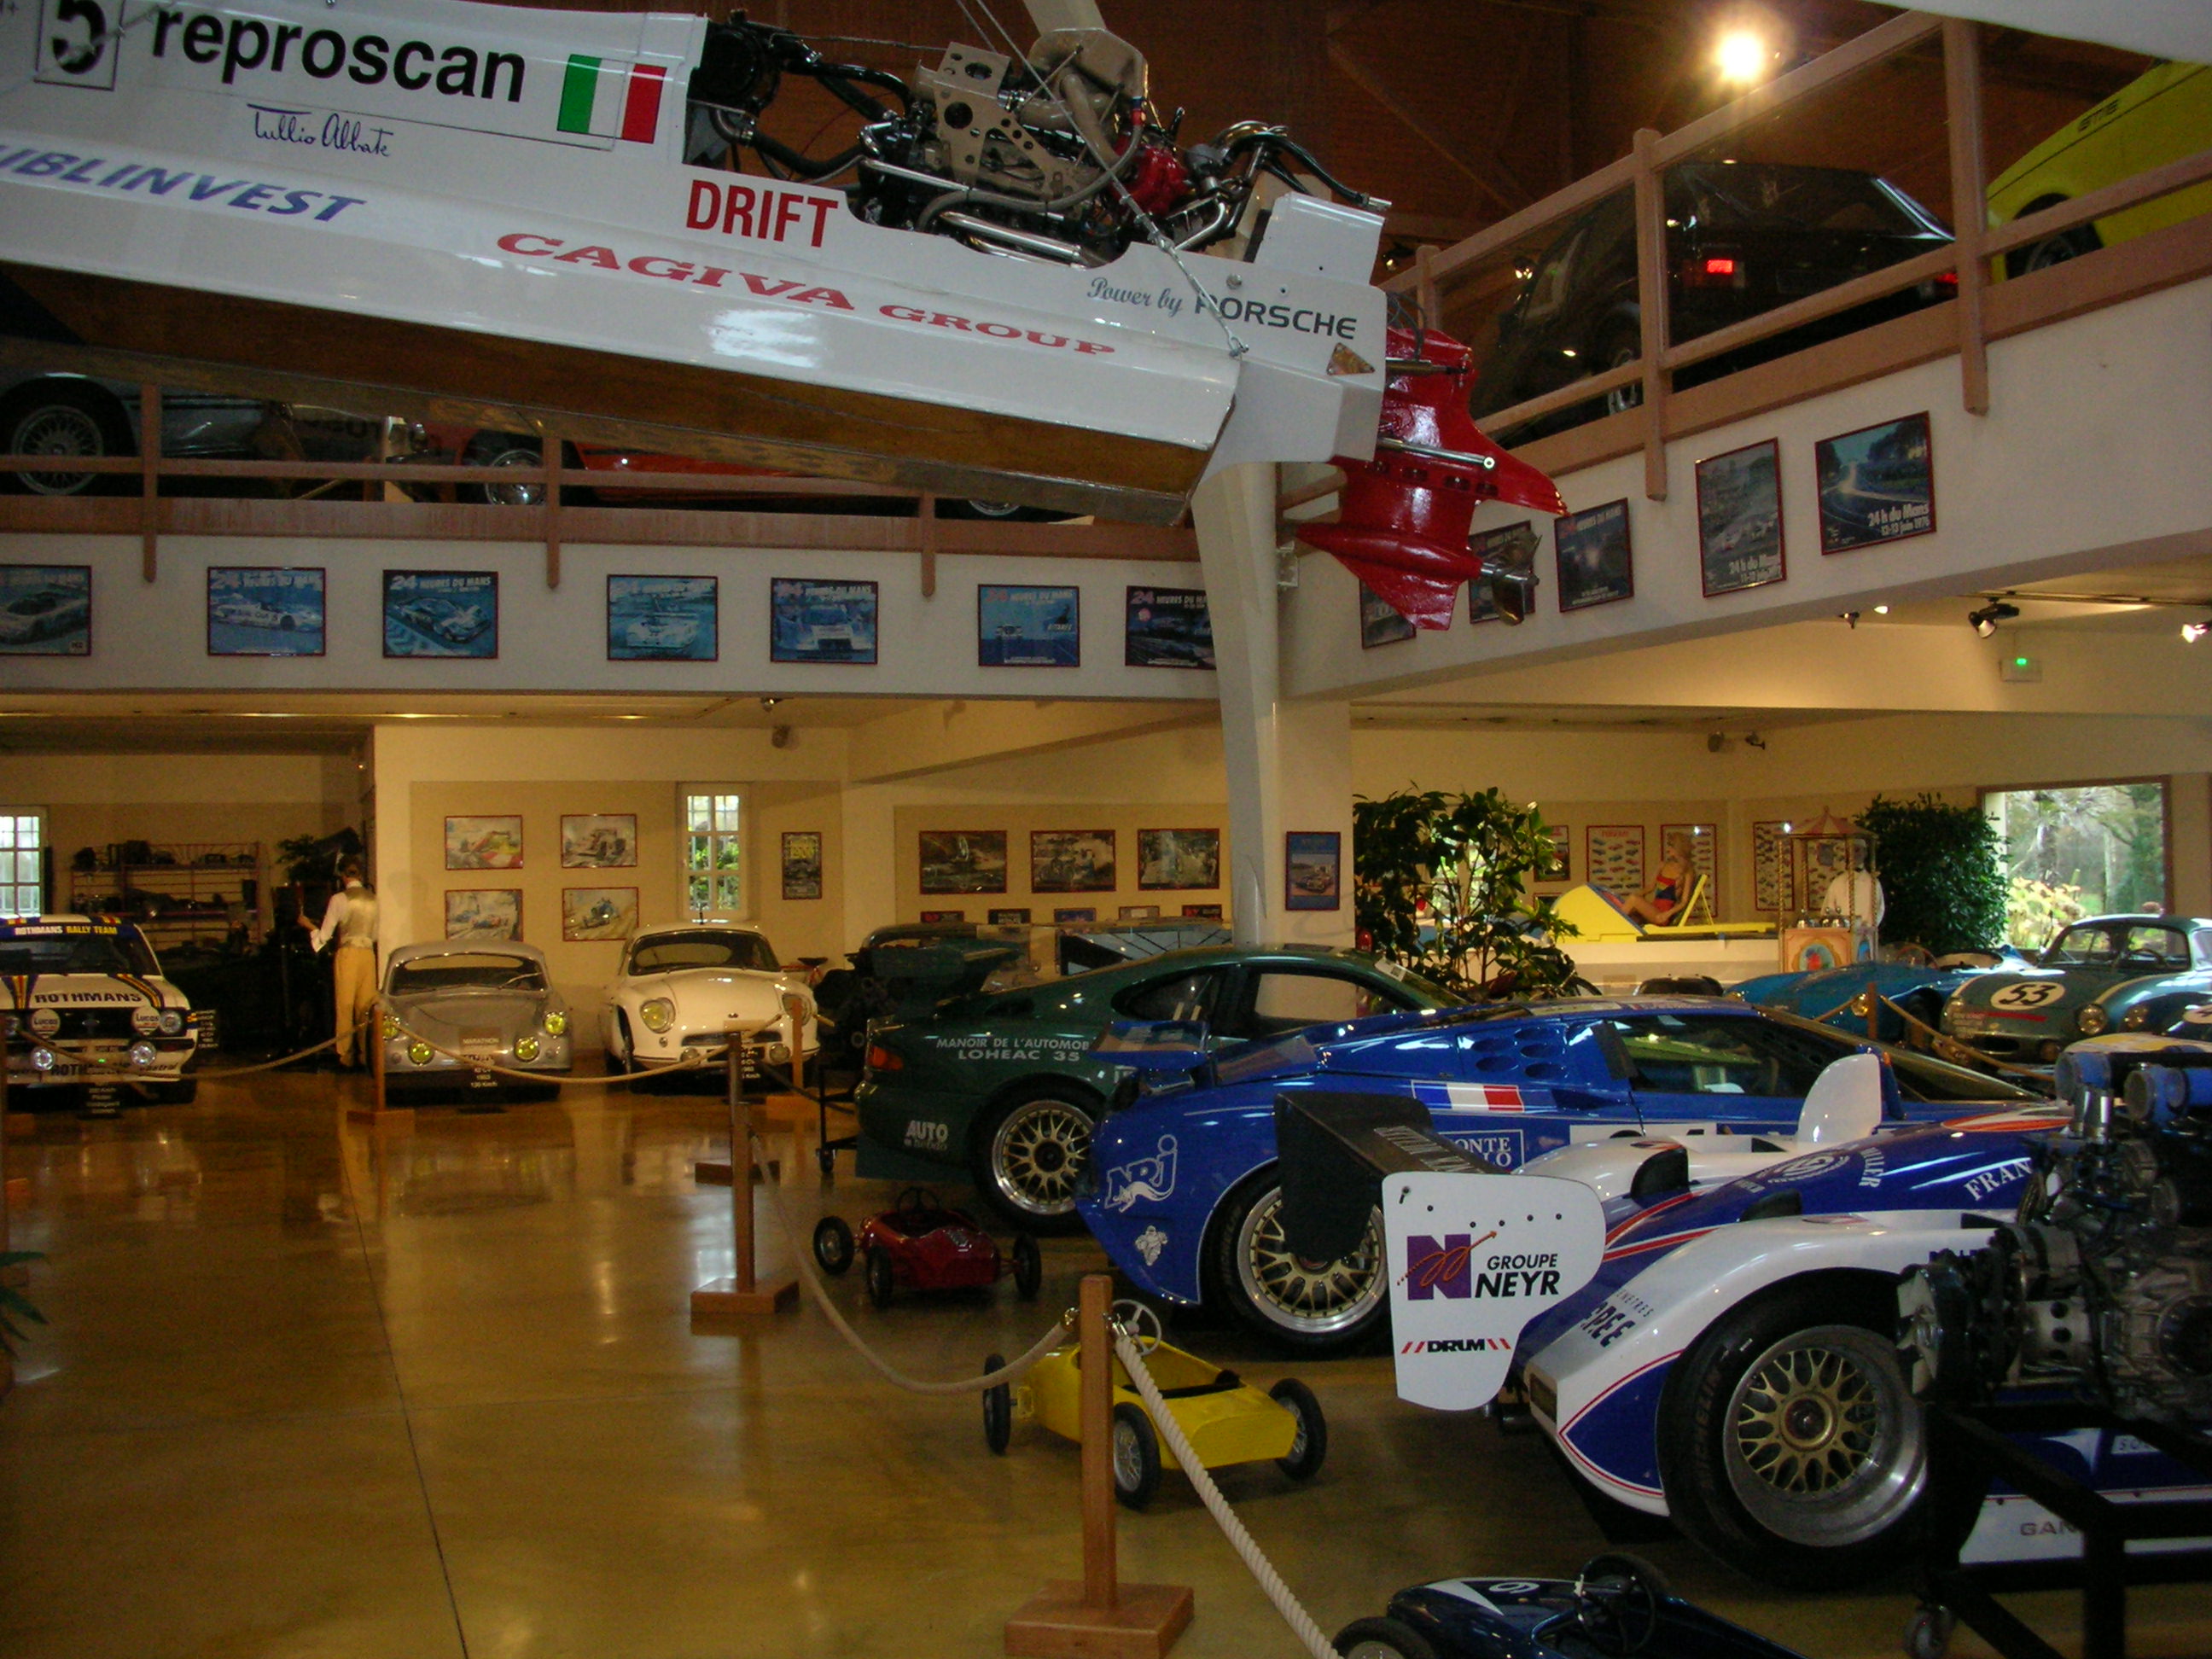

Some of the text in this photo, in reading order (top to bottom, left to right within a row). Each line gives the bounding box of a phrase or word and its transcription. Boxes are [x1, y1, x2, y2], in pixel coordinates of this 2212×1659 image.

[153, 10, 527, 104] reproscan
[686, 179, 840, 248] DRIFT
[497, 231, 1117, 356] CAGIVA GROUP
[1086, 276, 1184, 317] Power by
[1195, 294, 1358, 341] PORSCHE
[390, 575, 418, 590] 24
[15, 925, 118, 935] ROTHMANS RALLY TEAM
[34, 992, 143, 1004] ROTHMANS
[1999, 983, 2057, 1006] 53
[936, 1038, 1090, 1051] MANOIR DE L'AUTOMOB
[958, 1050, 1040, 1061] LOHEAC
[905, 1119, 949, 1144] AUTO
[1454, 1136, 1511, 1154] ONTE
[1964, 1159, 2034, 1202] FRAN
[1487, 1254, 1558, 1270] GROUPE
[1475, 1270, 1562, 1299] NEYR
[1427, 1339, 1487, 1353] DRUM
